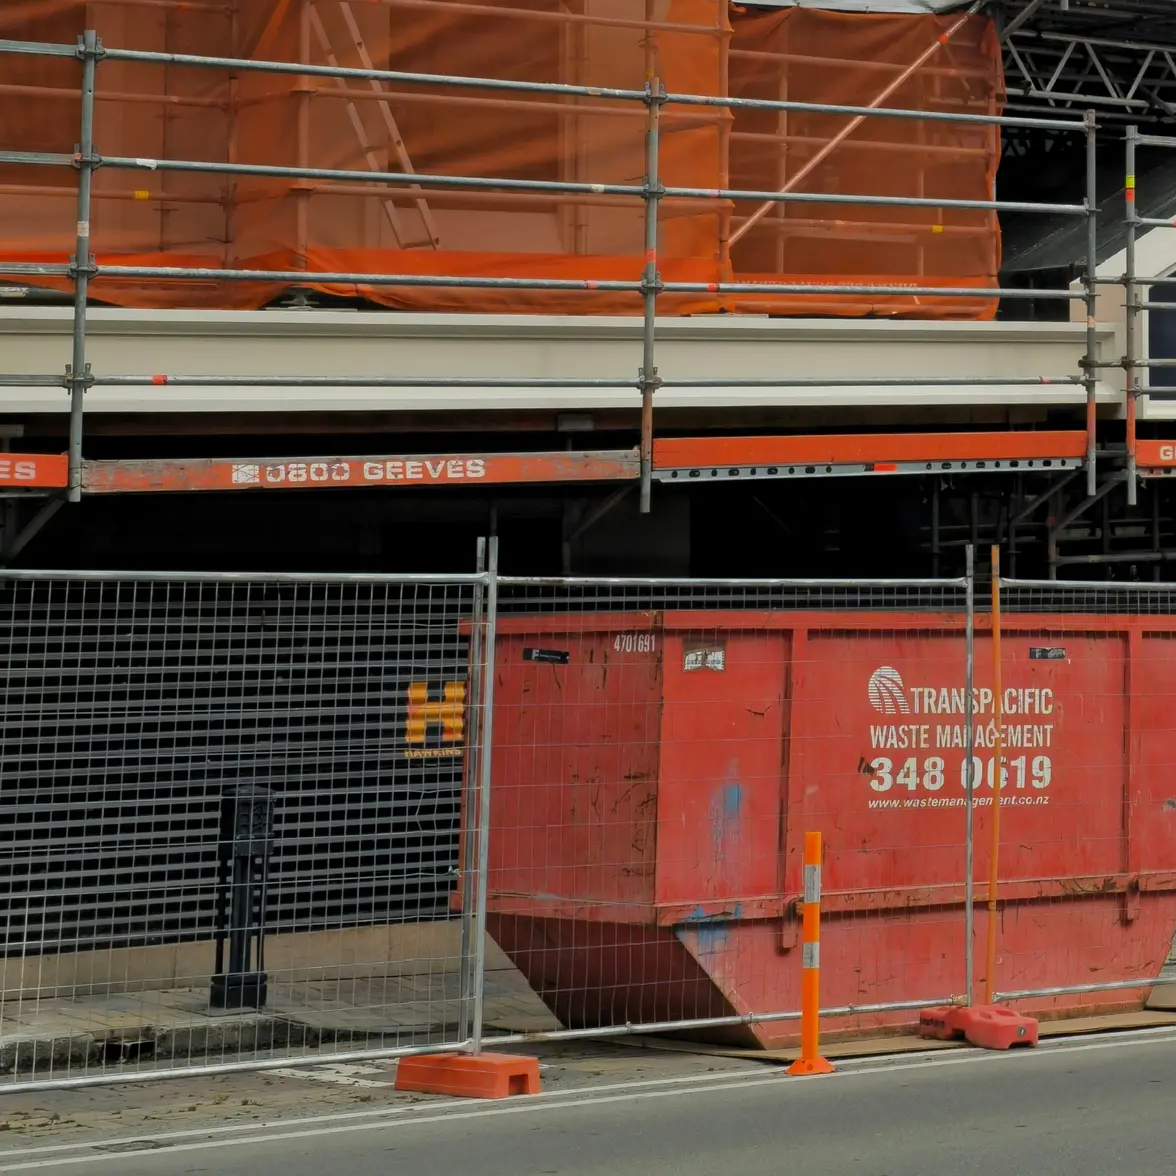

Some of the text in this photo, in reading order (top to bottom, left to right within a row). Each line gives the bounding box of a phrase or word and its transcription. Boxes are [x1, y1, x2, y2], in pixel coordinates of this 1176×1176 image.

[265, 459, 486, 483] 0800 GEEVES
[613, 634, 656, 653] 4701691
[405, 680, 465, 743] H
[870, 724, 1054, 749] WASTE MAAGEMENT
[403, 748, 461, 758] HAWKINS
[869, 755, 1052, 792] 348 0619
